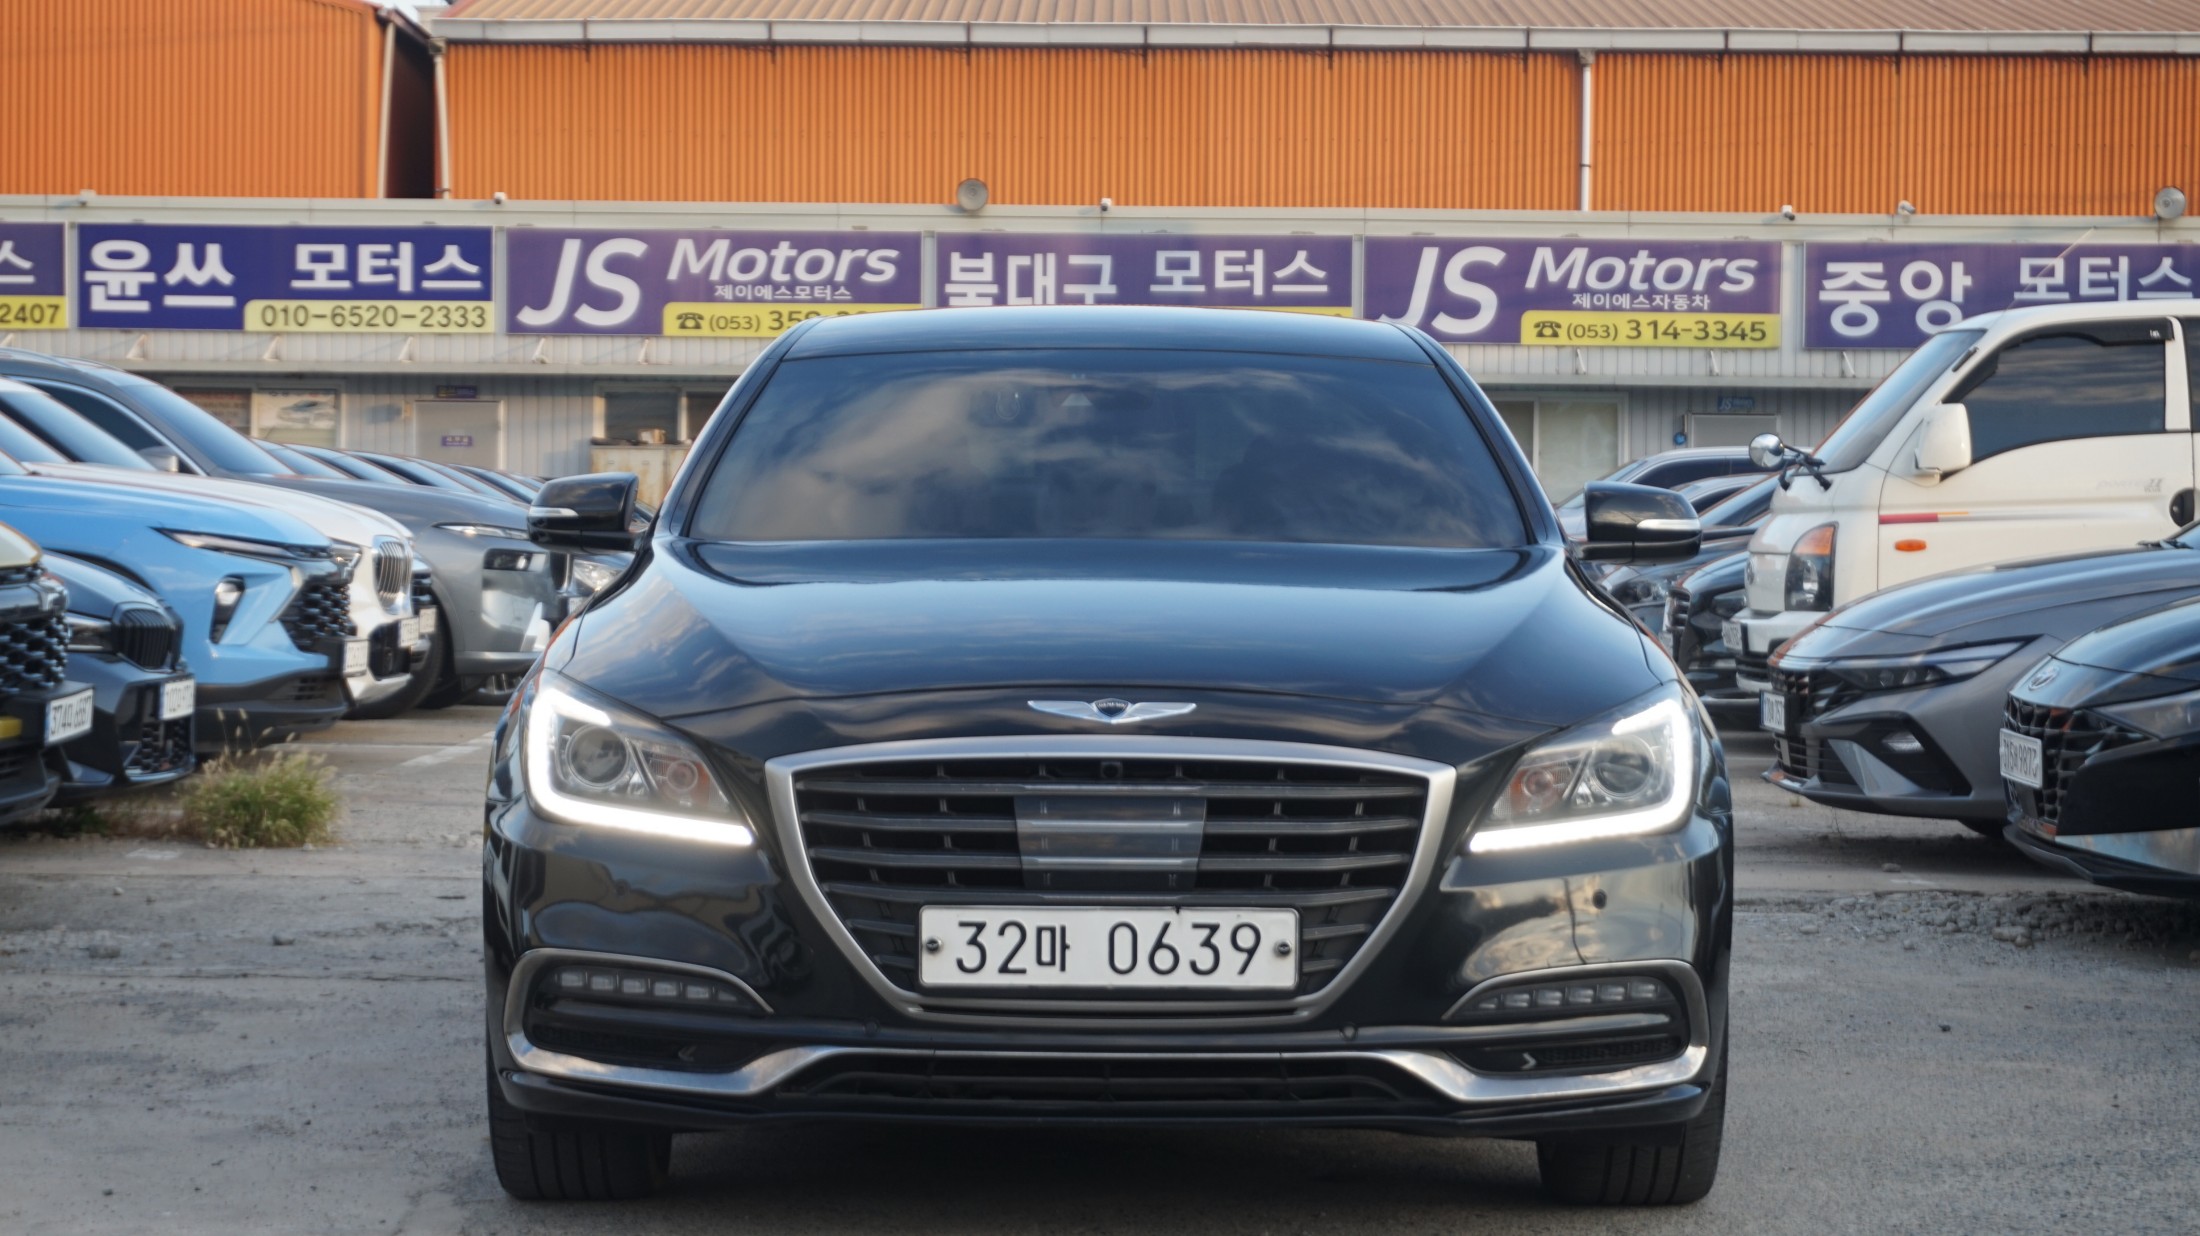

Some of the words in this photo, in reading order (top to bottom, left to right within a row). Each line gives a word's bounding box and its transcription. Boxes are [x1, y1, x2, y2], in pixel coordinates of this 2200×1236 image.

[84, 239, 236, 312] 윤쓰
[290, 241, 483, 293] 모터스
[516, 237, 649, 327] JS
[666, 238, 900, 283] Motors
[714, 284, 853, 301] 제이에스모터스
[944, 251, 1118, 305] 북대구
[1149, 248, 1329, 297] 모터스
[1379, 245, 1507, 334] JS
[1524, 246, 1759, 292] Motors
[1572, 293, 1711, 310] 제이에스자동차
[1818, 259, 1973, 337] 중앙
[2013, 254, 2194, 301] 모터스
[260, 304, 488, 328] 010-6520-2333
[708, 314, 761, 333] (053)
[1566, 323, 1619, 342] (053)
[1626, 319, 1767, 342] 314-3345
[956, 920, 1071, 975] 32마
[1108, 921, 1262, 976] 0639
